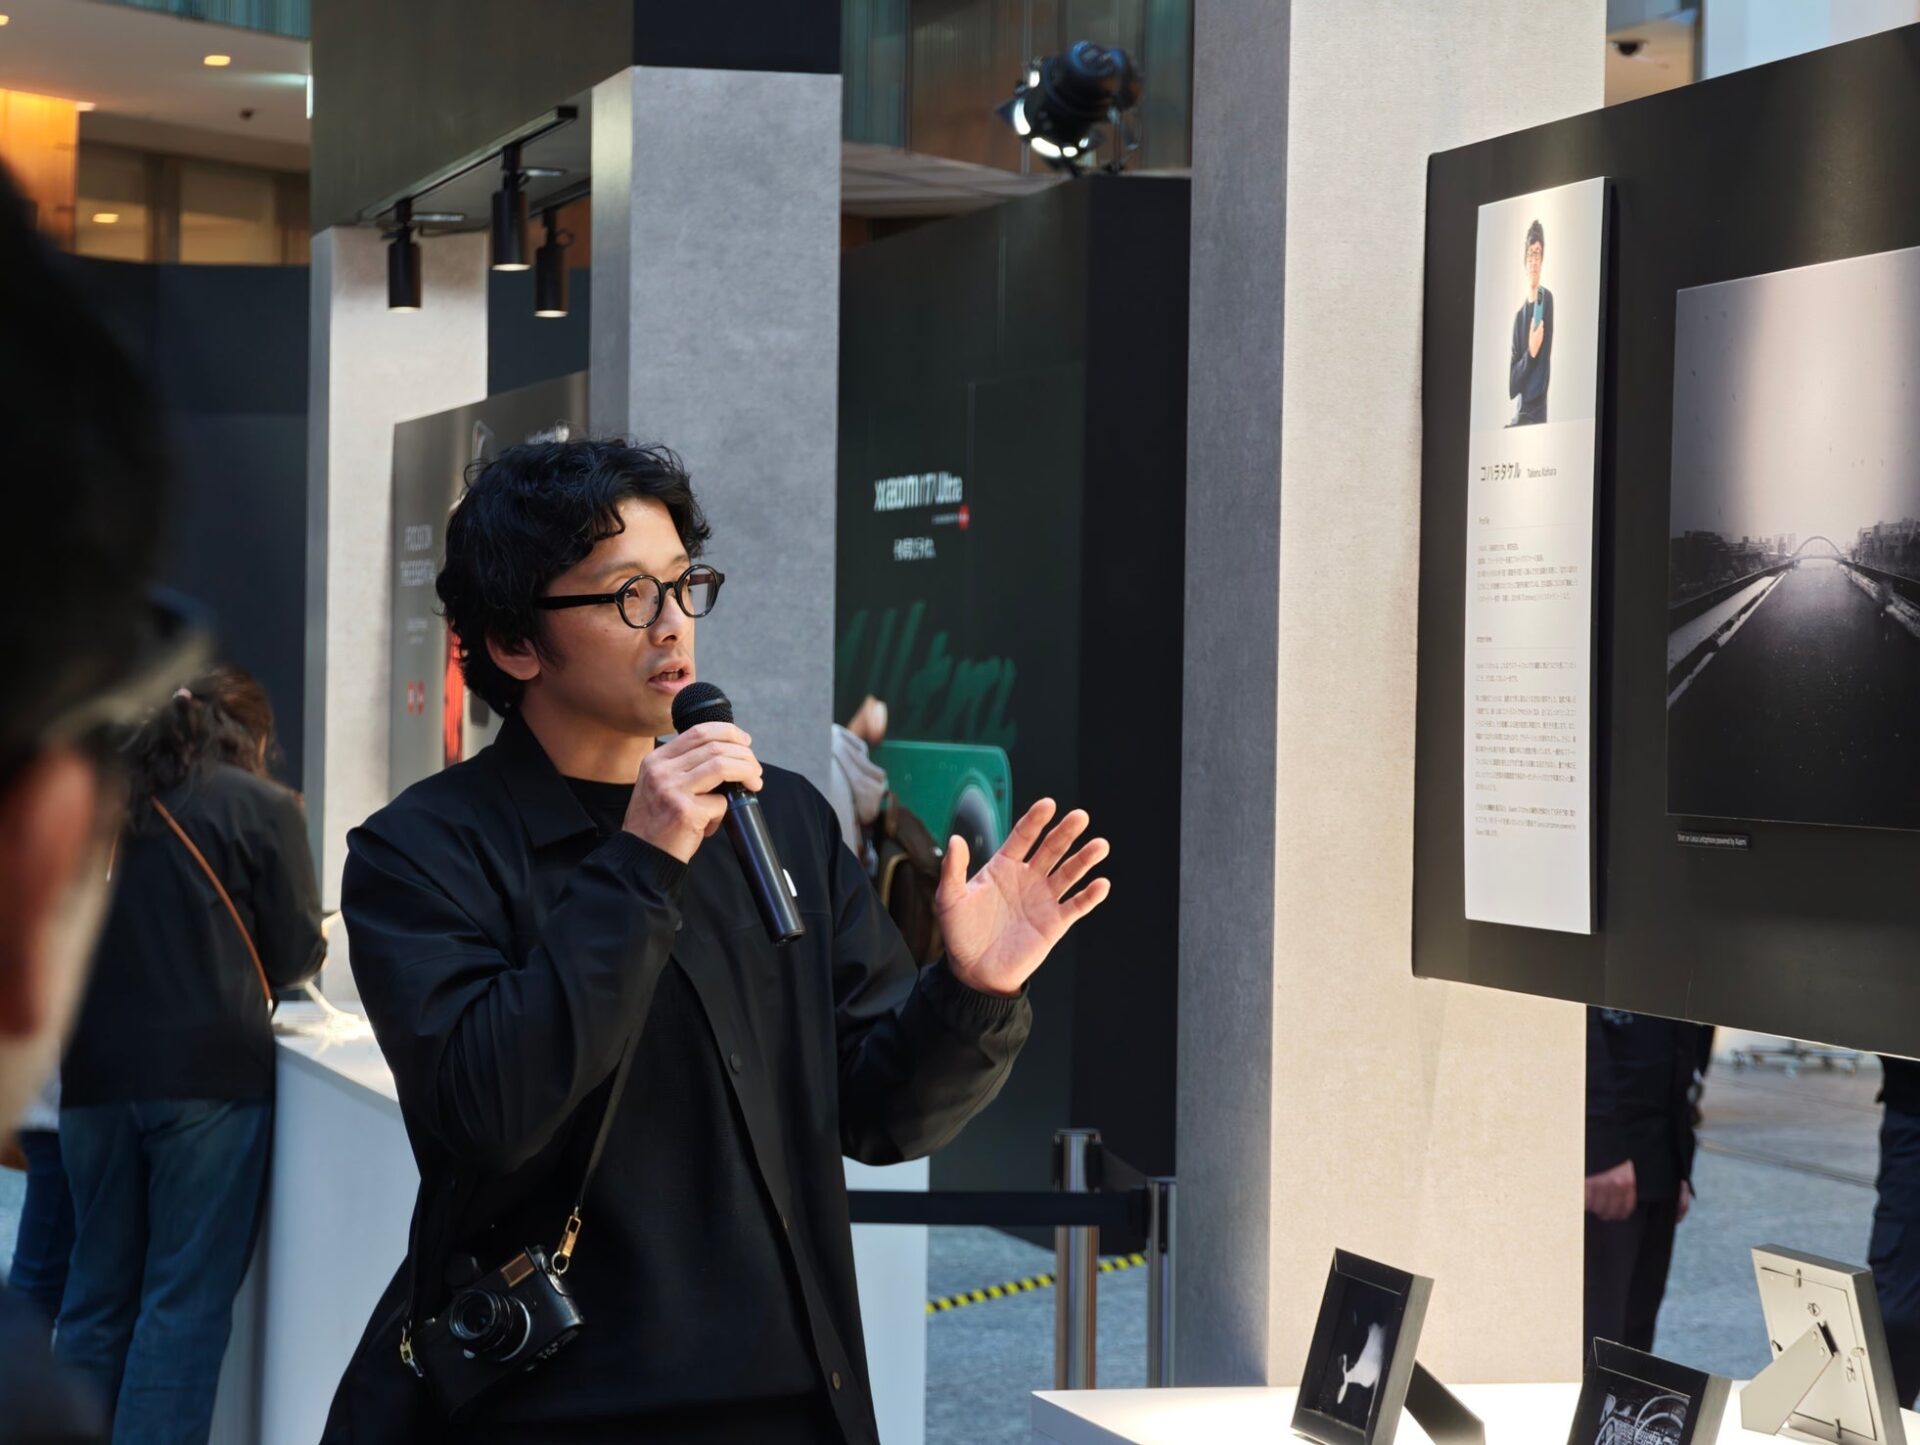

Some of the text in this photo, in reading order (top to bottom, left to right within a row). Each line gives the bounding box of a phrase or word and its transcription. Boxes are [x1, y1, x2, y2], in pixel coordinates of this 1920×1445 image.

[1480, 462, 1521, 482] コハラタケル
